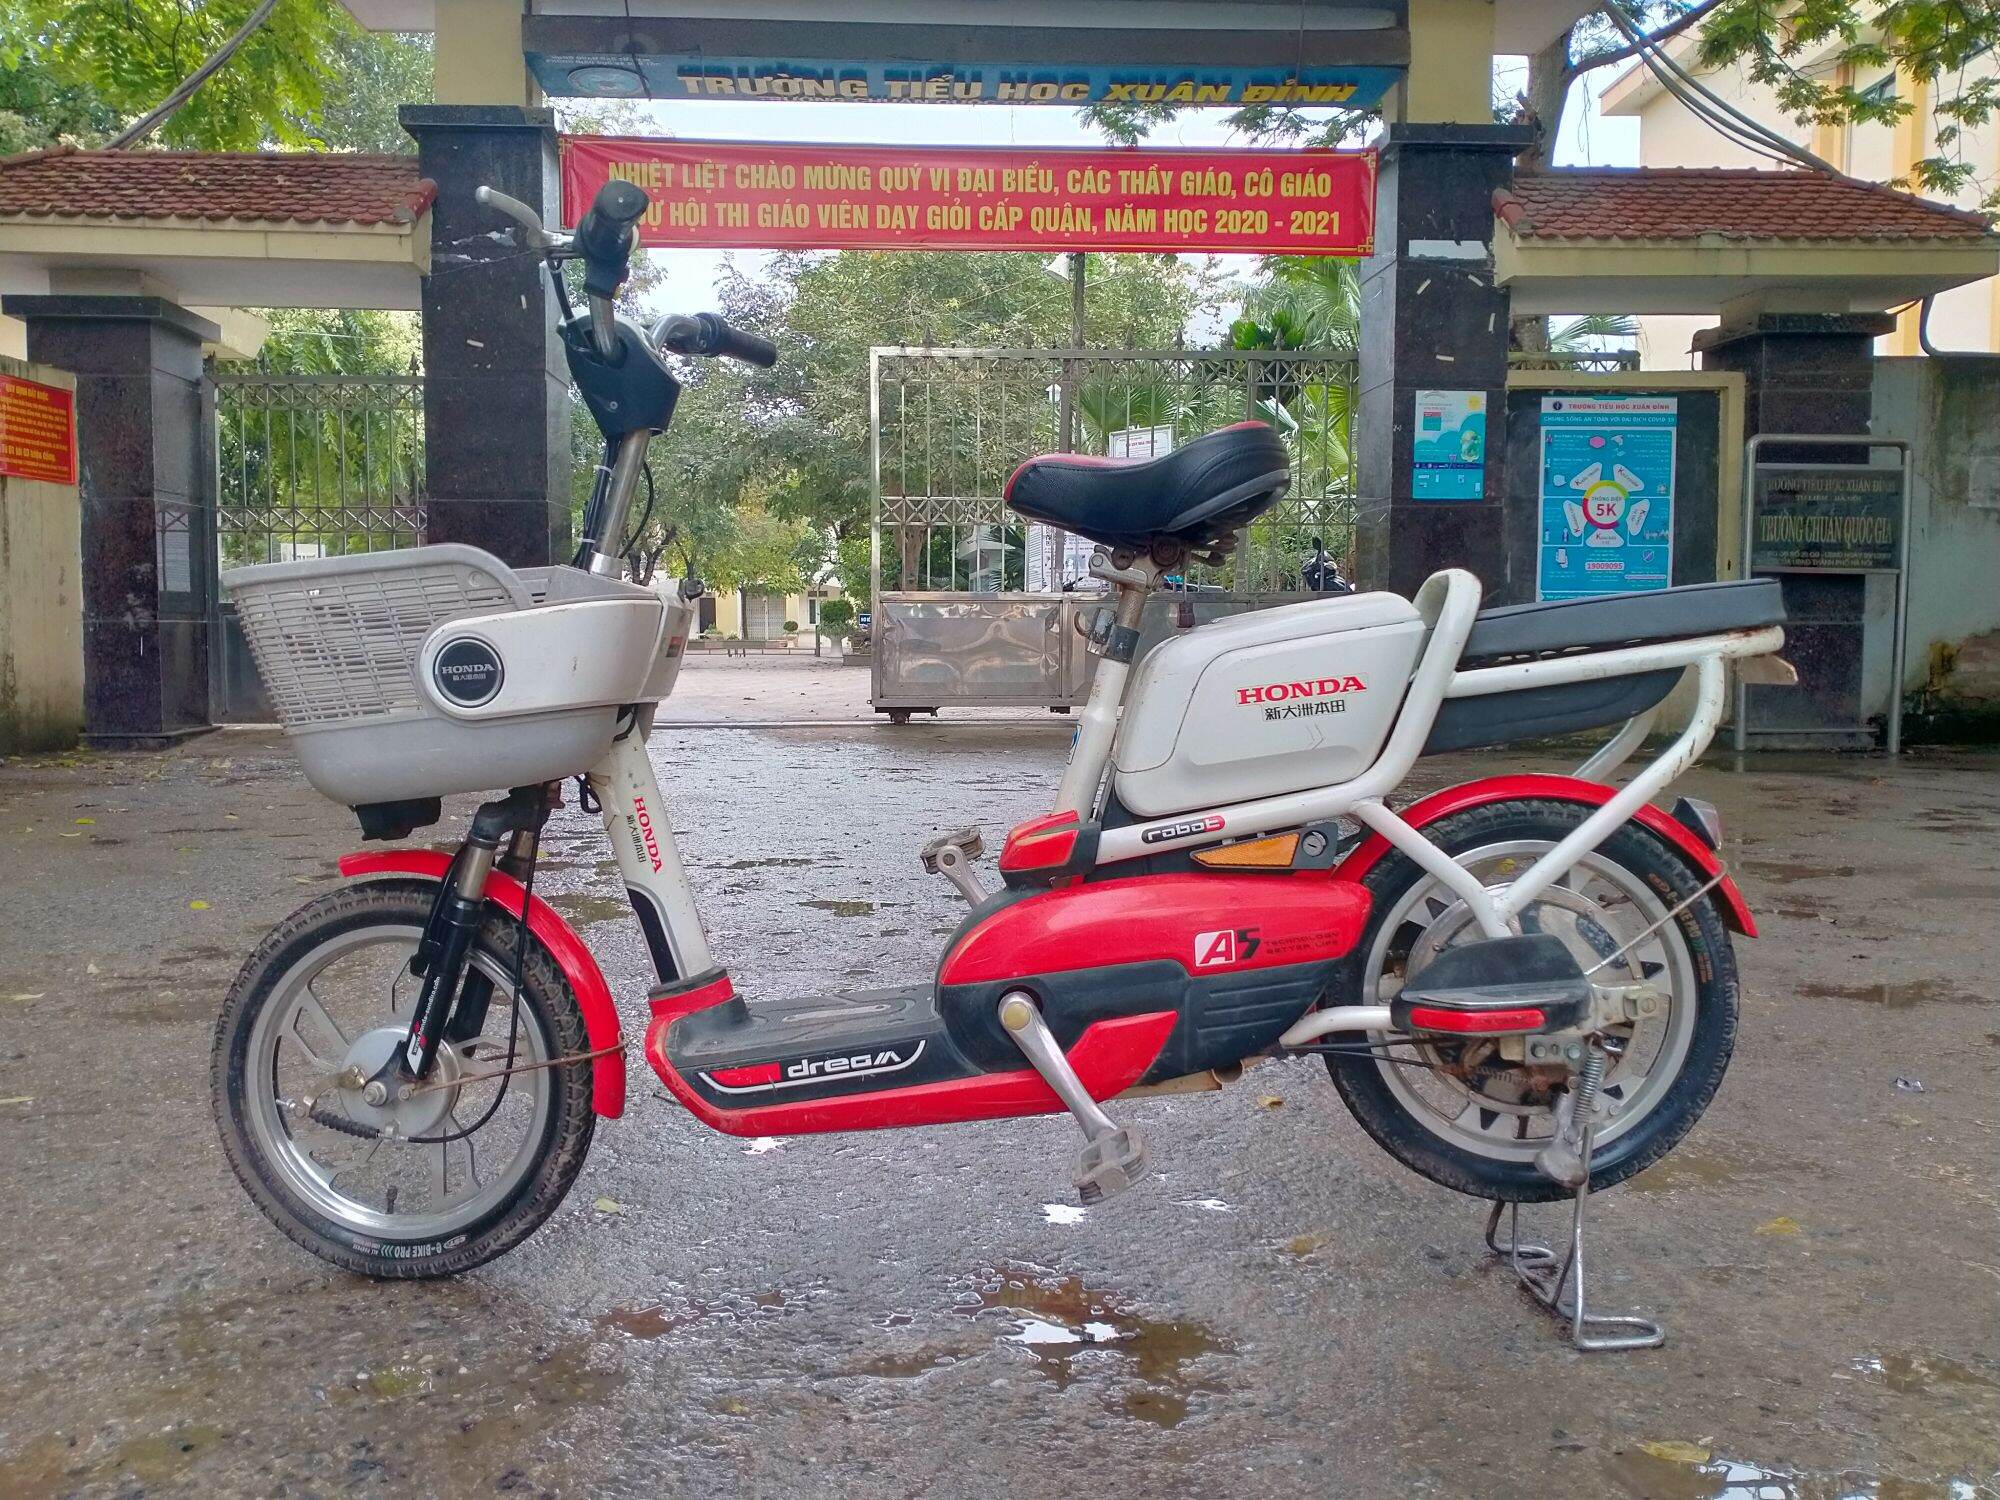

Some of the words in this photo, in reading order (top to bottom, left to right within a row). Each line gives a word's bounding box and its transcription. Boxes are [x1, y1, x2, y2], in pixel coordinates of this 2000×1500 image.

[678, 73, 867, 96] TRƯỜNG
[884, 74, 982, 99] TIỂU
[1101, 81, 1231, 102] XUÂN
[608, 158, 675, 193] NHIỆT
[682, 159, 728, 193] LIỆT
[736, 160, 796, 189] CHÀO
[804, 161, 871, 191] MỪNG
[879, 163, 923, 193] QUÝ
[929, 168, 949, 197] VỊ
[957, 168, 994, 197] ĐẠI
[1002, 160, 1059, 196] BIỂU,
[1067, 165, 1111, 194] CÁC
[1118, 164, 1173, 195] THẦY
[1181, 166, 1236, 199] GIÁO,
[1244, 167, 1273, 196] CÔ
[1280, 168, 1332, 197] GIÁO
[669, 197, 707, 232] HỘI
[714, 203, 749, 227] THI
[758, 199, 810, 228] GIÁO
[817, 199, 868, 229] VIÊN
[876, 204, 919, 234] DẠY
[927, 198, 971, 230] GIỎI
[979, 198, 1023, 231] CẤP
[1030, 202, 1097, 237] QUẬN,
[1105, 203, 1157, 233] NĂM
[1164, 209, 1208, 238] HỌC
[1214, 209, 1268, 234] 2020
[1290, 210, 1339, 235] 2021
[1596, 503, 1617, 516] 5K
[442, 663, 496, 674] HONDA
[1237, 676, 1367, 704] HONDA
[1264, 700, 1345, 721] 新大洲本田
[633, 797, 662, 873] HONDA
[1148, 819, 1220, 841] robot
[394, 1245, 411, 1258] PRO
